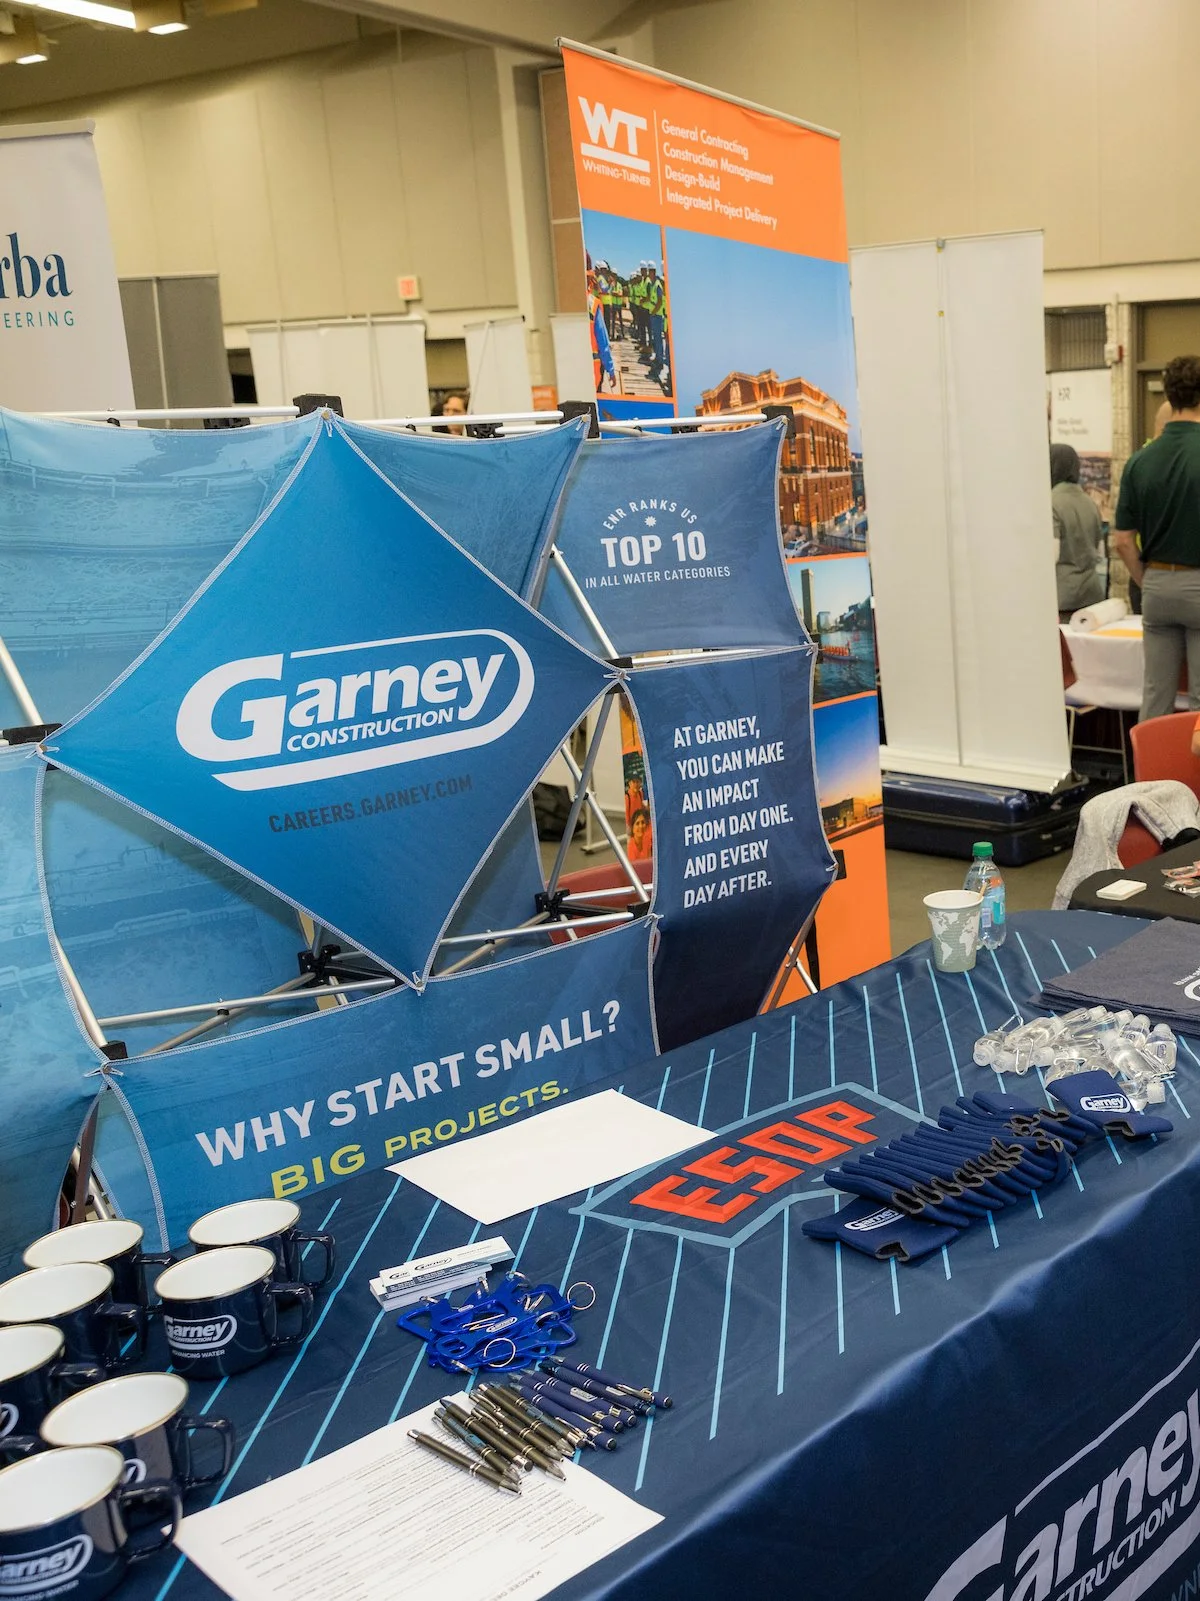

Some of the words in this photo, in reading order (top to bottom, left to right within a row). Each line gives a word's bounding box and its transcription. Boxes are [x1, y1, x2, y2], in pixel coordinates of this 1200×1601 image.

[578, 96, 647, 155] WT
[661, 119, 698, 142] General
[700, 129, 749, 161] Contracting
[582, 158, 651, 187] WHITING-TURNER
[663, 142, 719, 169] Construction
[720, 157, 774, 185] Management
[665, 165, 720, 192] Design-Build
[666, 187, 713, 211] Integrated
[714, 199, 743, 220] Project
[744, 206, 777, 231] Delivery
[4, 310, 76, 329] EERING
[603, 508, 627, 531] ENR
[628, 499, 678, 513] RANKS
[680, 508, 698, 524] US
[601, 534, 662, 568] TOP
[672, 530, 707, 562] 10
[585, 577, 597, 589] IN
[600, 574, 621, 588] ALL
[623, 570, 661, 585] WATER
[664, 565, 731, 581] CATEGORIES
[176, 653, 506, 762] Garney
[287, 706, 454, 752] CONSTRUCTION
[674, 726, 692, 749] AT
[695, 715, 760, 745] GARNEY,
[676, 756, 709, 781] YOU
[711, 749, 743, 775] CAN
[745, 741, 785, 768] MAKE
[268, 774, 473, 833] CAREERS.GARNEY.COM
[682, 793, 703, 814] AN
[706, 778, 760, 809] IMPACT
[684, 818, 726, 847] FROM
[730, 810, 758, 836] DAY
[760, 803, 794, 828] ONE.
[683, 852, 717, 880] AND
[720, 839, 769, 869] EVERY
[683, 883, 718, 909] DAY
[717, 870, 772, 899] AFTER.
[195, 1099, 316, 1167] WHY
[328, 1052, 467, 1128] START
[475, 1000, 621, 1079] SMALL?
[1080, 1097, 1123, 1110] Garney
[270, 1144, 366, 1200] BIG
[385, 1080, 569, 1159] PROJECTS.
[629, 1100, 879, 1224] ESOP
[414, 1258, 448, 1271] Garney
[164, 1315, 229, 1341] Garney
[201, 1349, 226, 1358] WATER
[1056, 1491, 1177, 1601] TRUCTION
